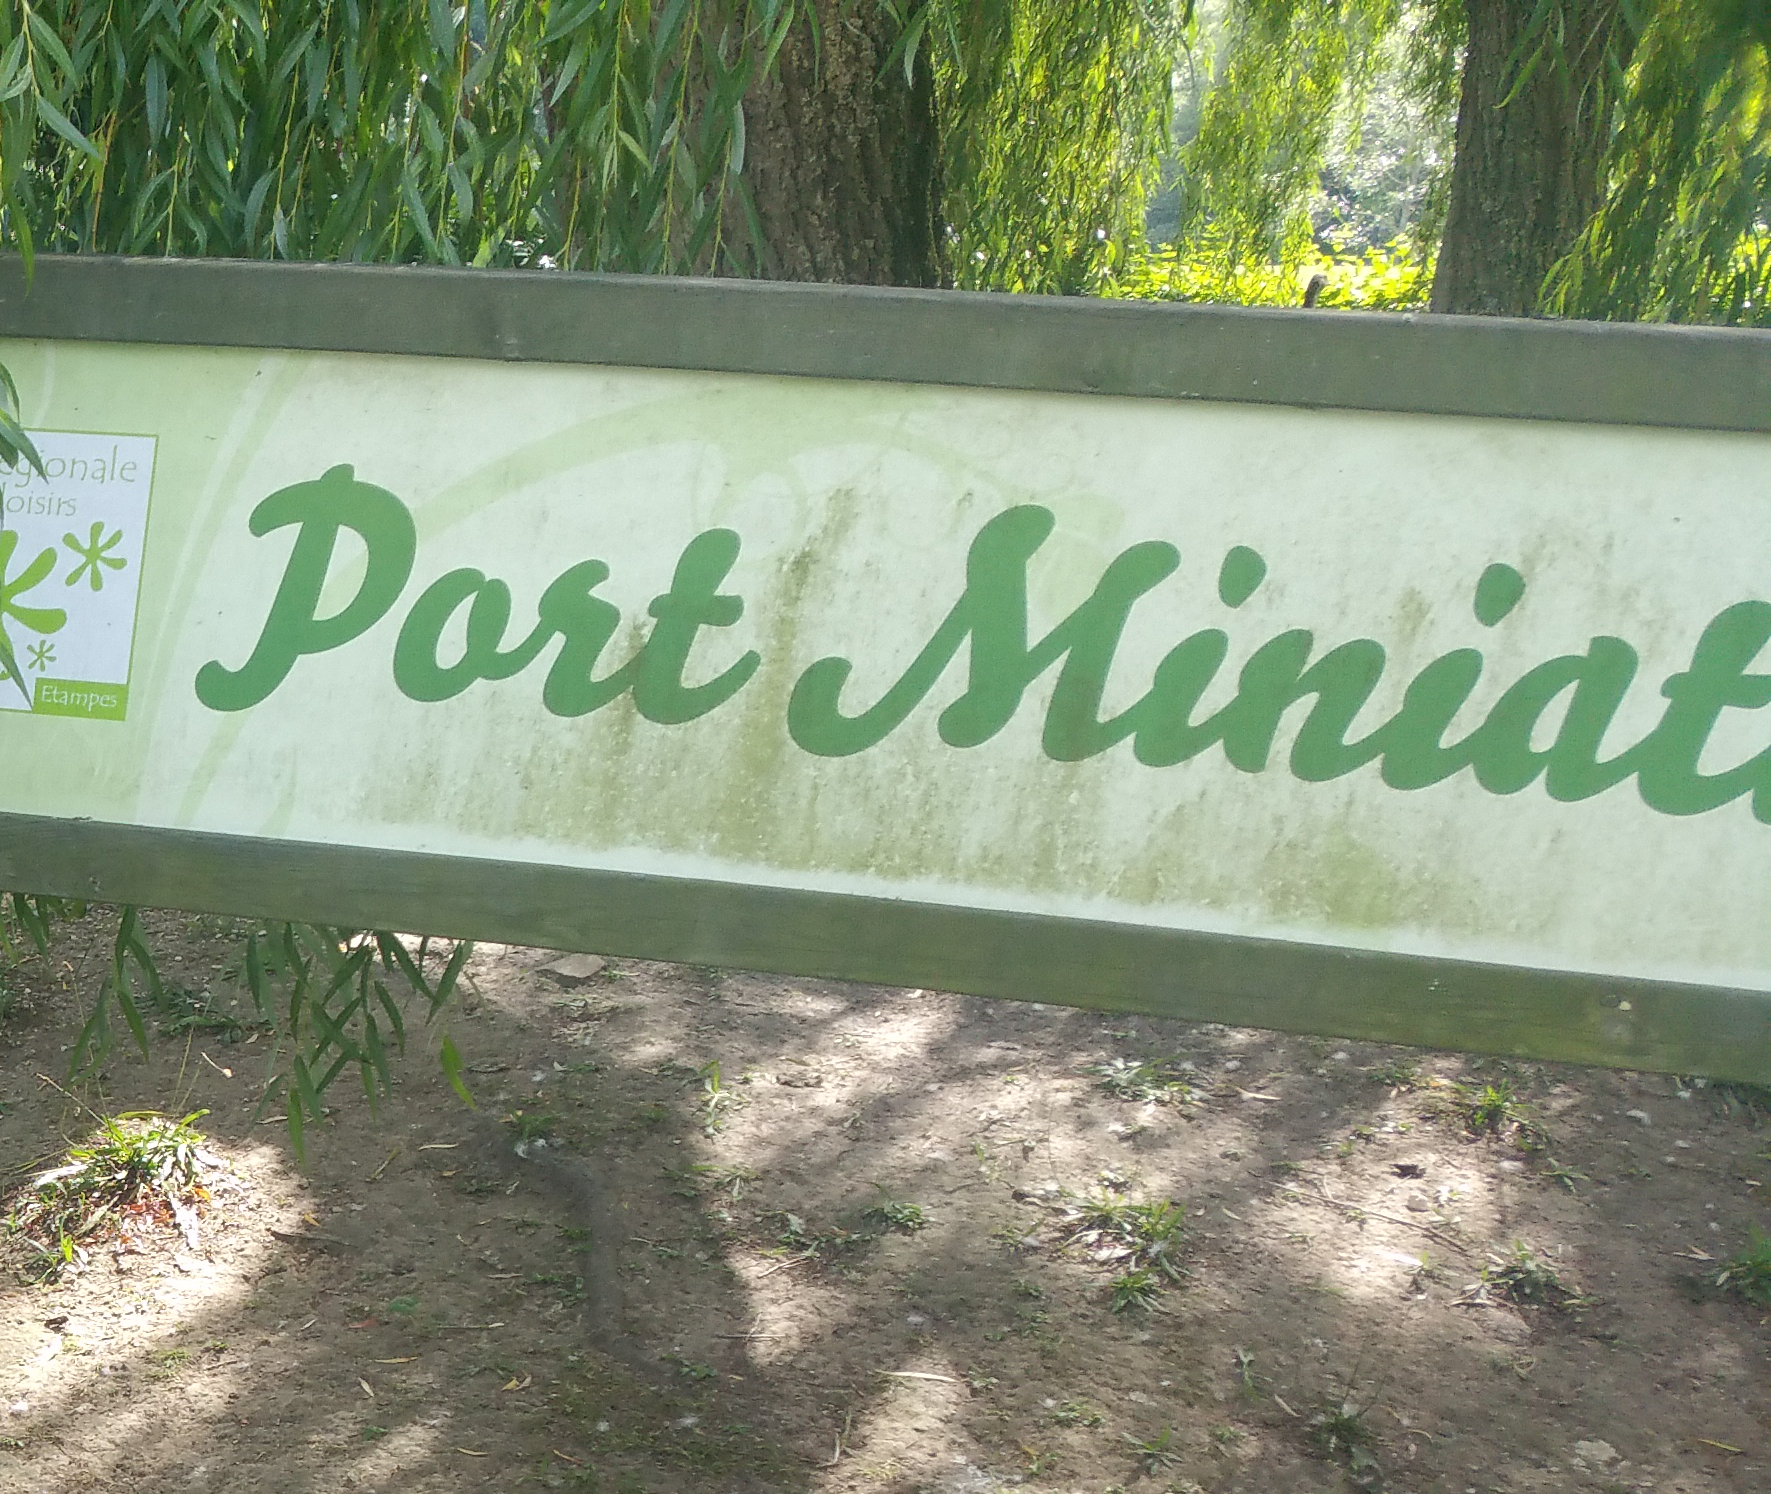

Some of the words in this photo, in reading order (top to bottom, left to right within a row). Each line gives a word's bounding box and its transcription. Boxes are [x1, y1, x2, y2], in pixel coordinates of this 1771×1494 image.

[41, 685, 118, 712] Etampes
[195, 464, 761, 720] Port
[788, 505, 1771, 825] Miniat
